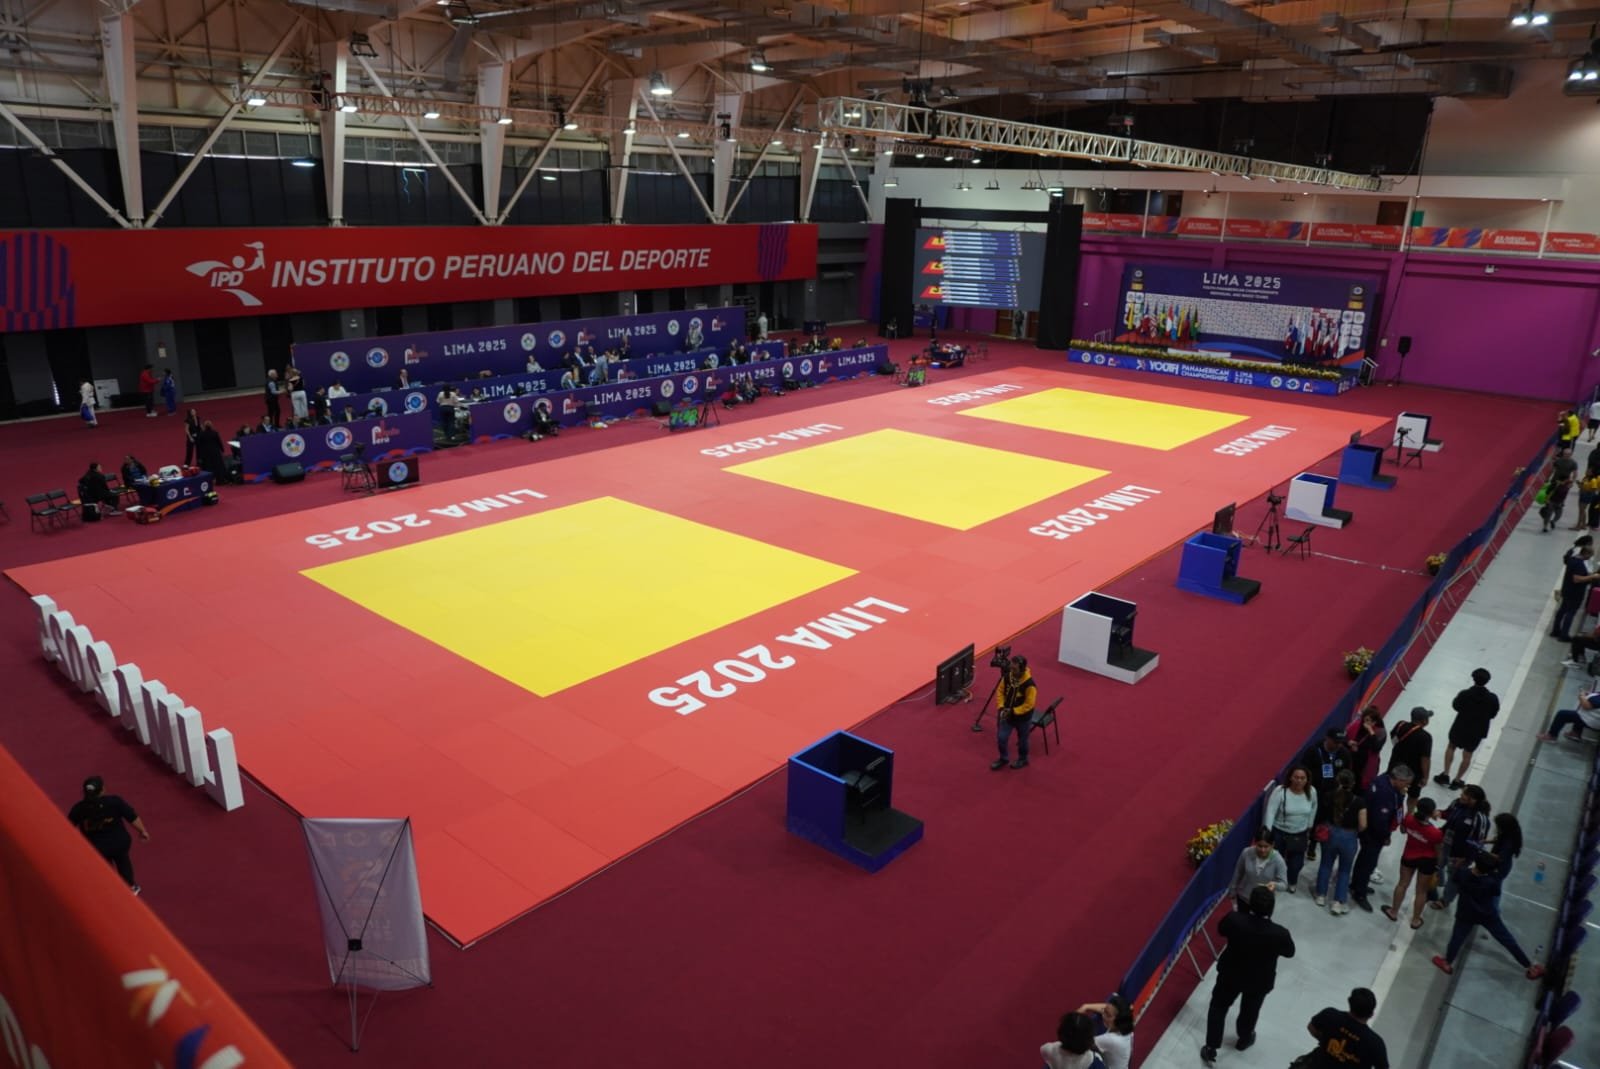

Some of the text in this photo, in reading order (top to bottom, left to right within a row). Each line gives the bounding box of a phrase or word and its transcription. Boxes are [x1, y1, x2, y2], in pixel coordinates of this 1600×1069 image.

[271, 248, 711, 288] INSTITUTO PERUANO DEL DEPORTE
[210, 271, 244, 288] IPD
[1203, 272, 1281, 289] LIMA 2025
[608, 326, 632, 338] LIMA
[635, 324, 657, 337] 2025
[444, 342, 475, 357] LIMA
[478, 338, 507, 353] 2025
[647, 363, 672, 375] LIMA
[674, 359, 696, 371] 2025
[838, 356, 856, 367] LIMA
[858, 353, 876, 364] 2025
[1149, 360, 1179, 375] YOUTH
[482, 384, 514, 398] LIMA
[594, 390, 622, 406] LIMA
[625, 386, 651, 401] 2025
[700, 423, 844, 458] LIMA 2025
[305, 488, 548, 549] LIMA 2025
[1028, 484, 1162, 540] LIMA 2025
[648, 596, 910, 715] LIMA 2025
